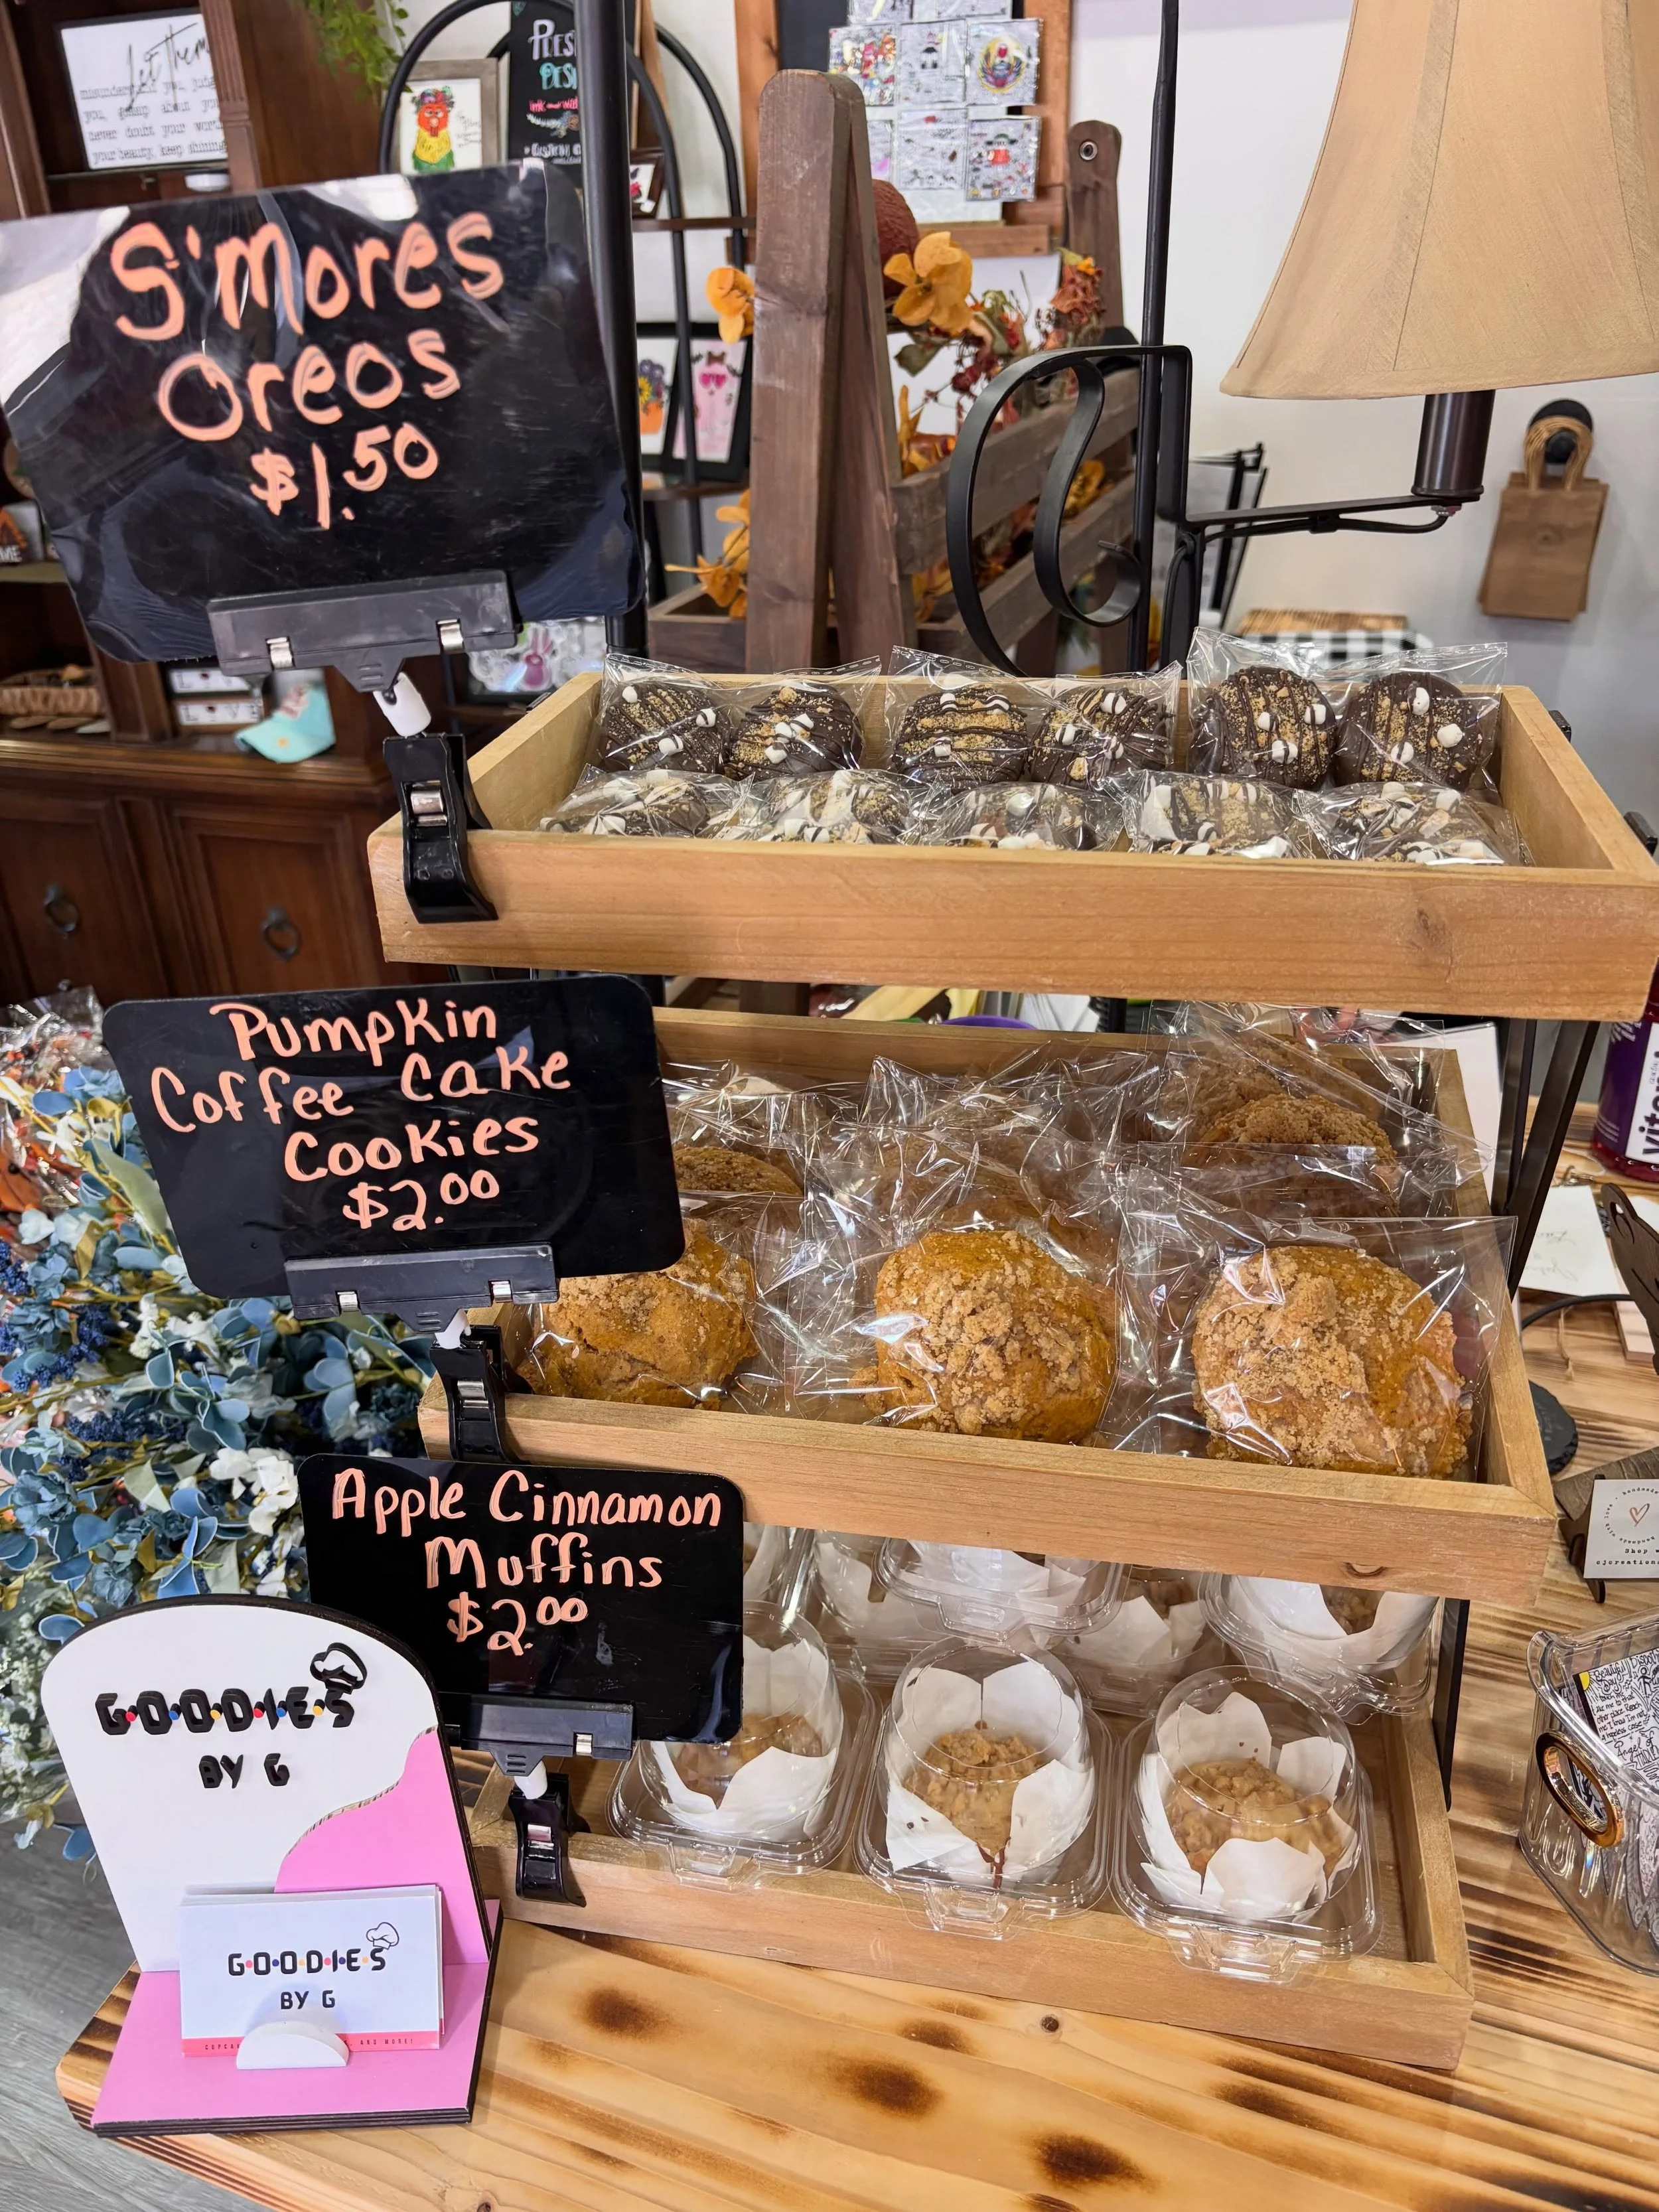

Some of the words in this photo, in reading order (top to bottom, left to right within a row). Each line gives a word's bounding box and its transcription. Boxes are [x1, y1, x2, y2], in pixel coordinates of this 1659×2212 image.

[157, 328, 460, 441] Oreos
[250, 422, 439, 530] $1.50
[150, 1065, 354, 1134] Coffee
[342, 1170, 500, 1232] $2.00
[332, 1467, 467, 1538] Apple
[489, 1469, 721, 1527] Cinnamon
[424, 1532, 664, 1589] Muffins
[447, 1591, 589, 1657] $2.00
[198, 1753, 244, 1789] BY
[263, 1753, 290, 1787] G
[279, 1990, 310, 2010] BY
[321, 1990, 336, 2009] G
